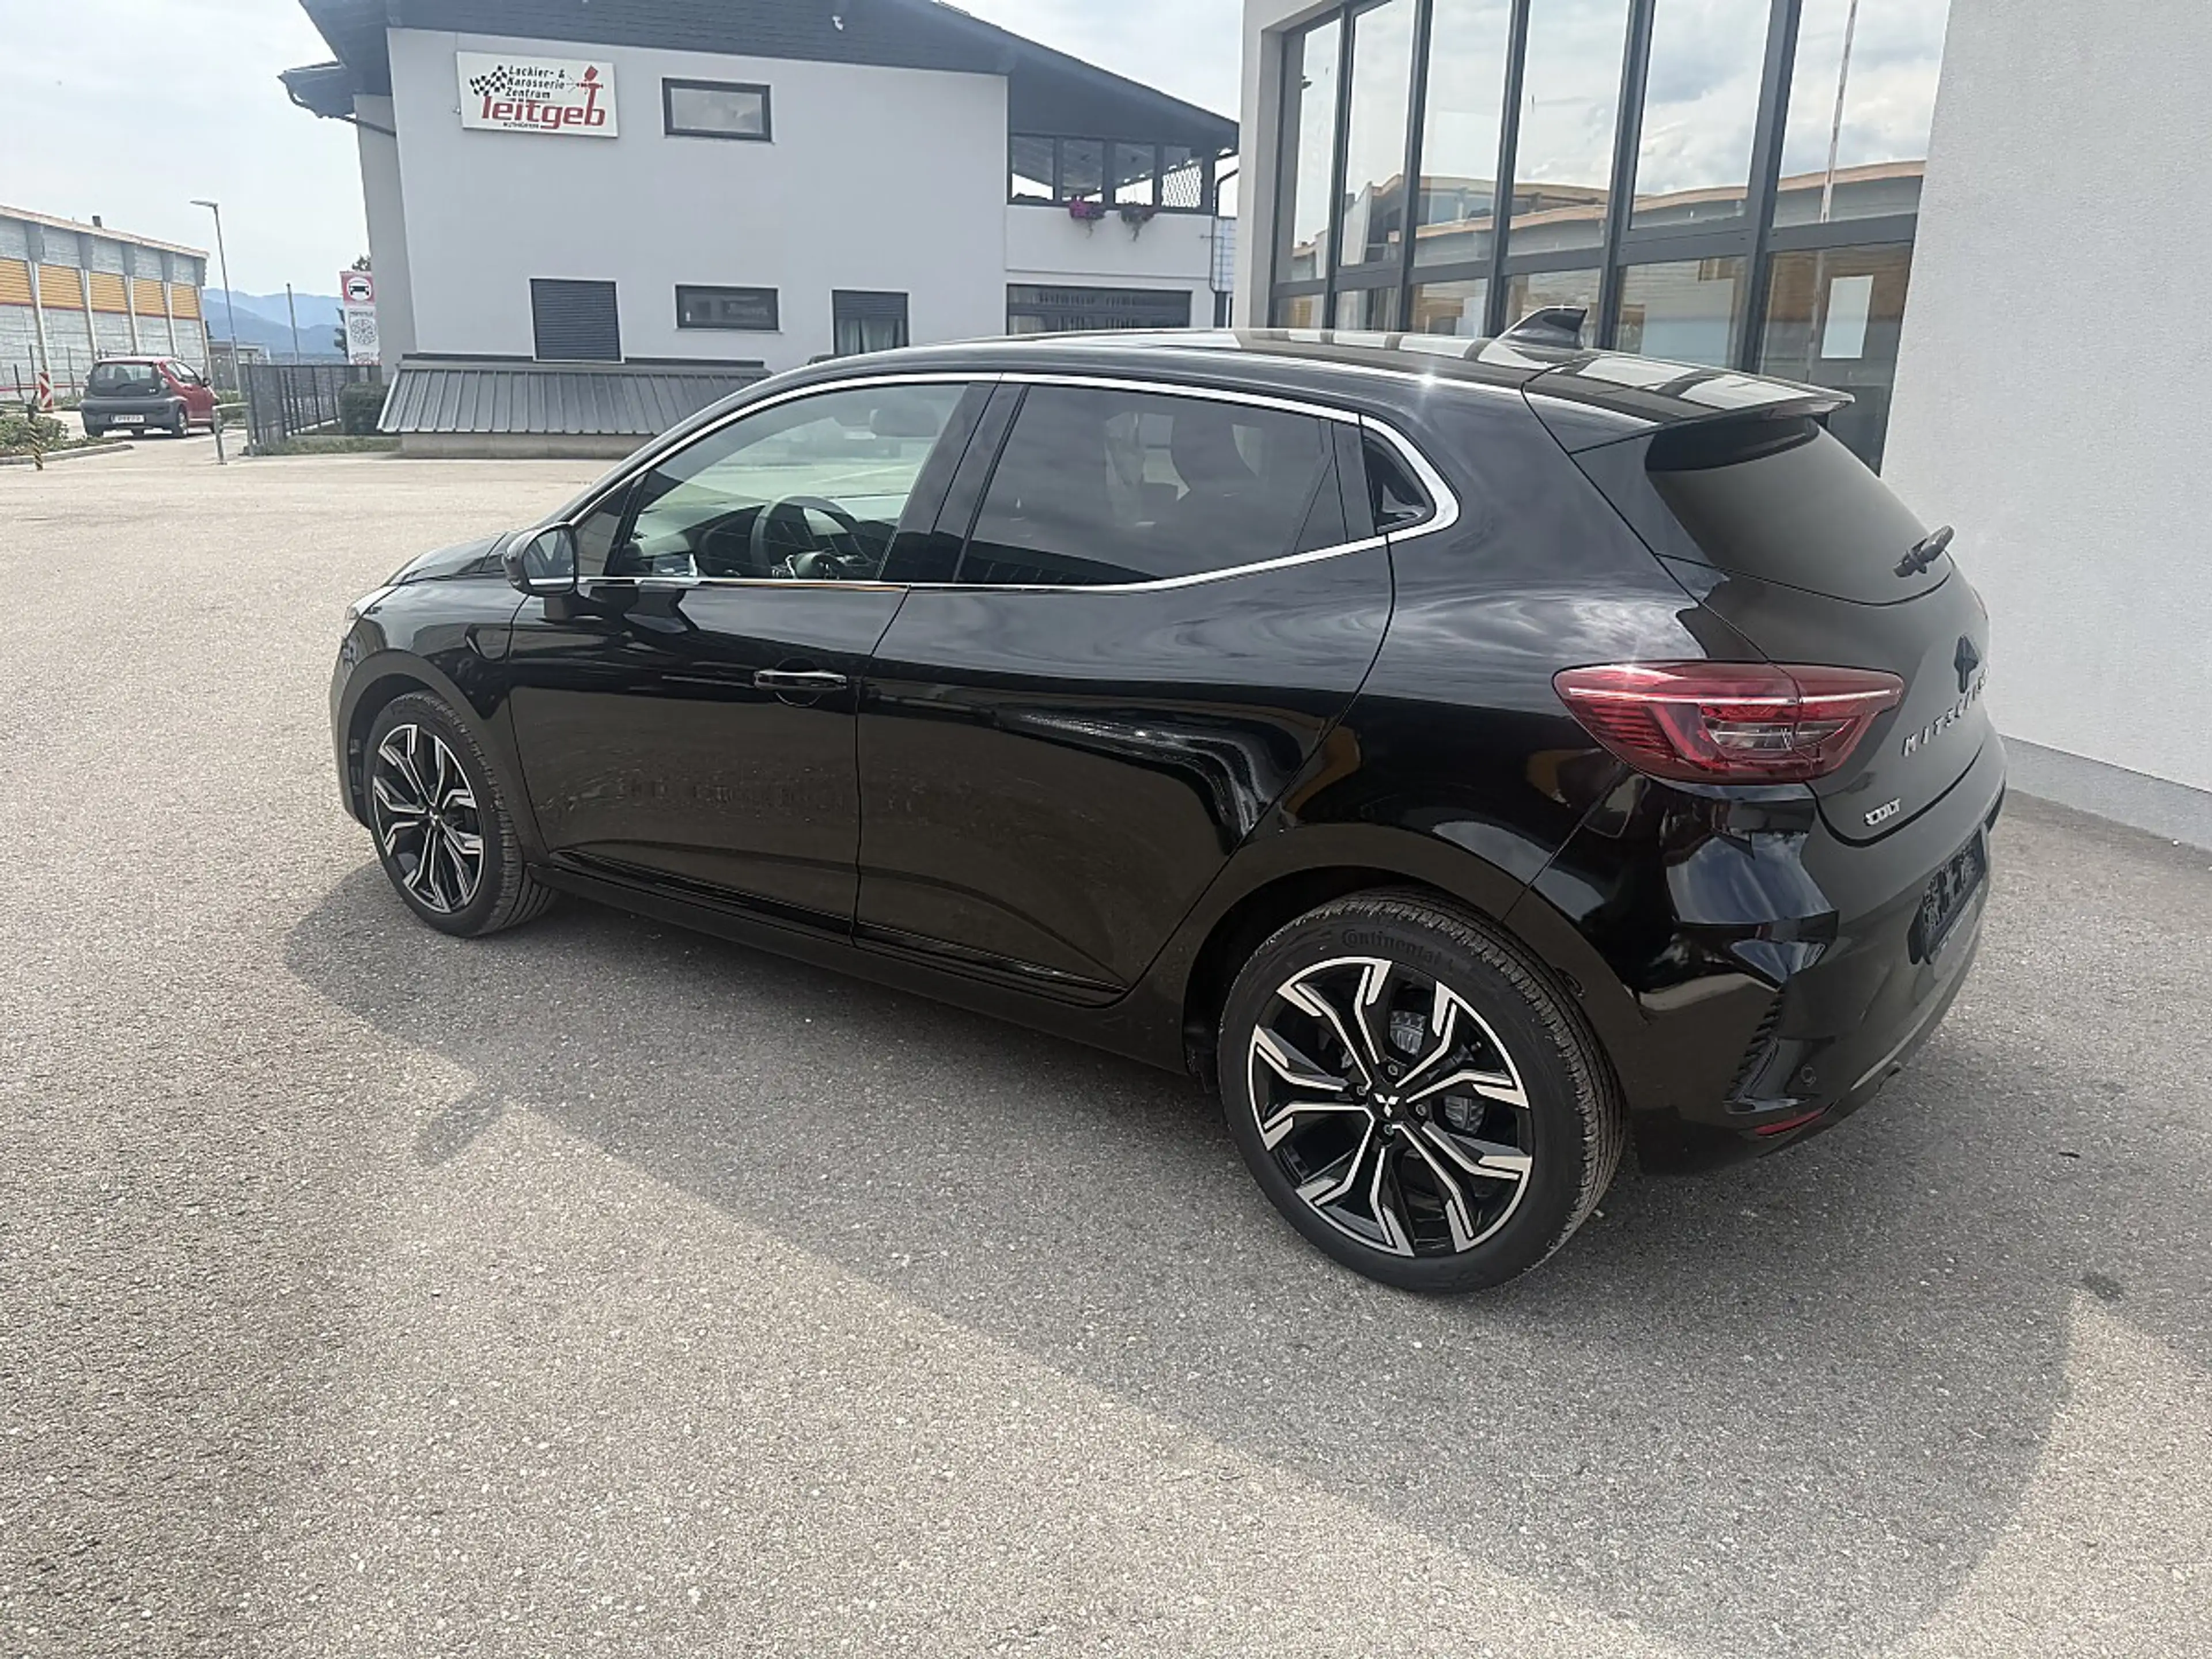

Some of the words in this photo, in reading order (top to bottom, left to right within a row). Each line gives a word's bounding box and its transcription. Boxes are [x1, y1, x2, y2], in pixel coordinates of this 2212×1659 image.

[558, 69, 565, 78] &
[507, 77, 565, 89] Karosserie
[505, 87, 550, 99] Zentrum
[1864, 798, 1900, 826] COLT
[1342, 929, 1442, 965] Continental
